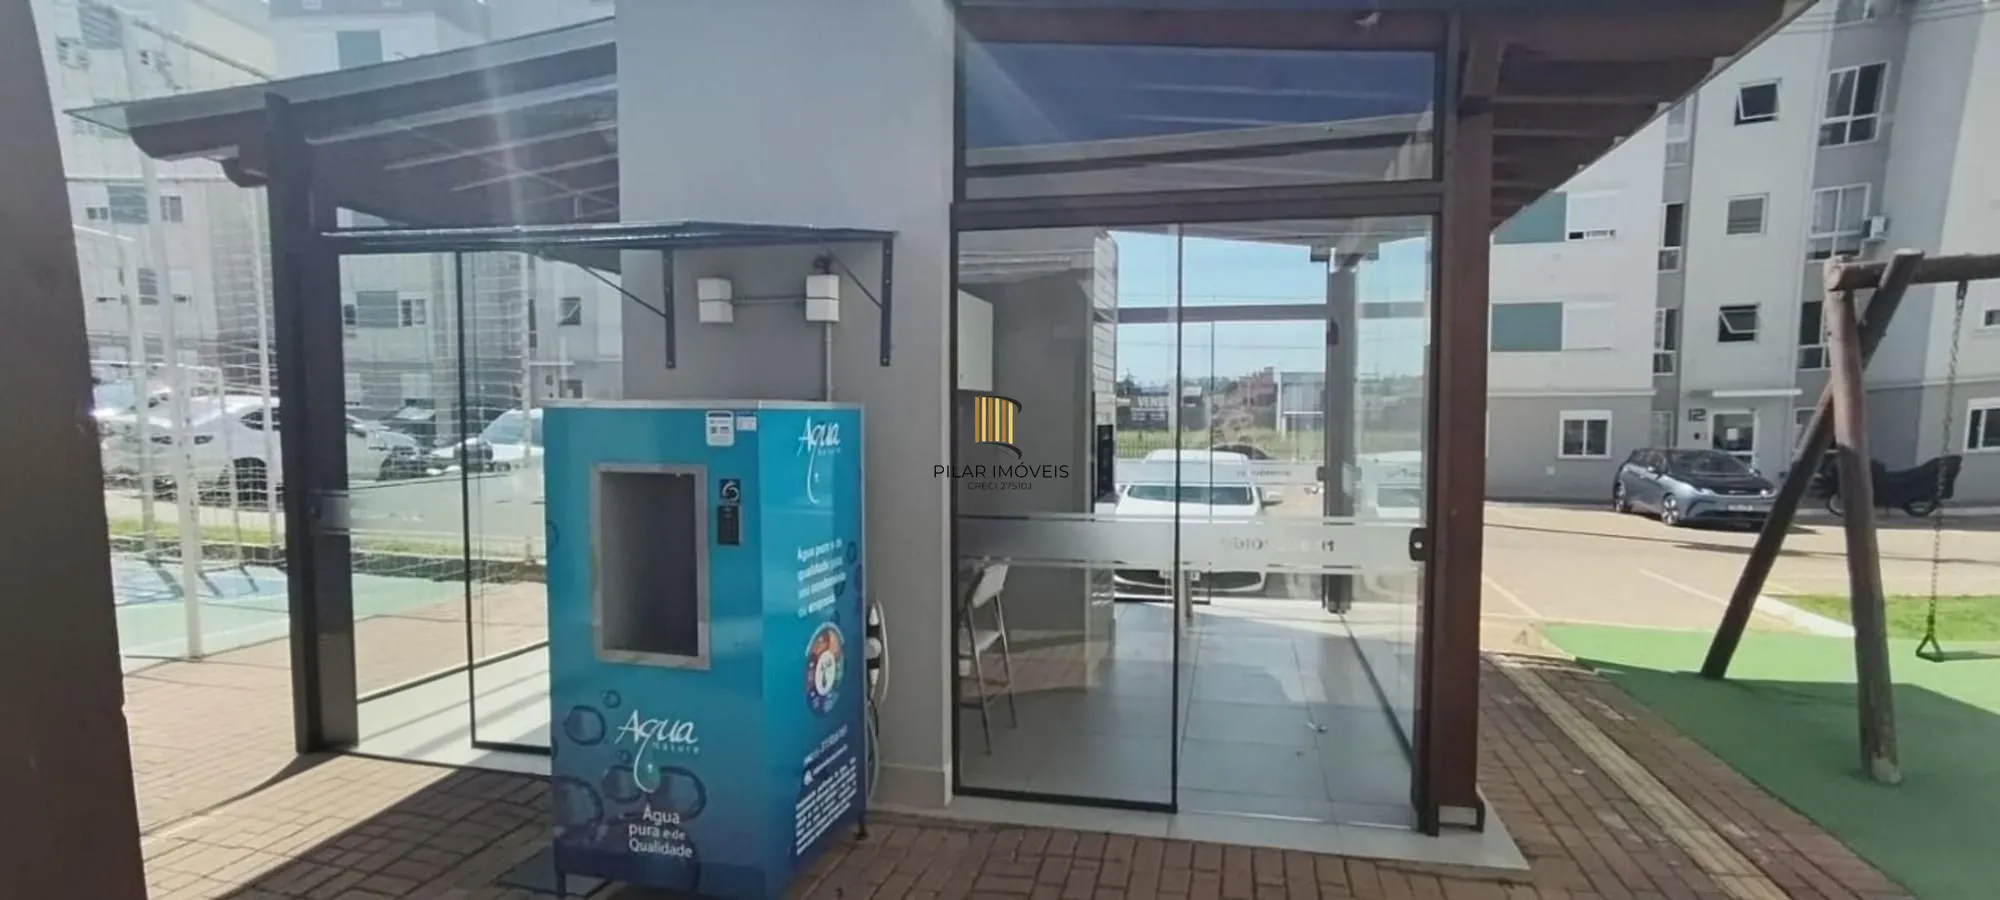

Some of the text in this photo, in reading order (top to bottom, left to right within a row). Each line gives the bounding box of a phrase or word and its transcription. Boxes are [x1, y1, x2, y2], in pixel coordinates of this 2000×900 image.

[1688, 408, 1706, 422] 12
[628, 823, 660, 838] pura
[628, 837, 693, 858] Qualidade
